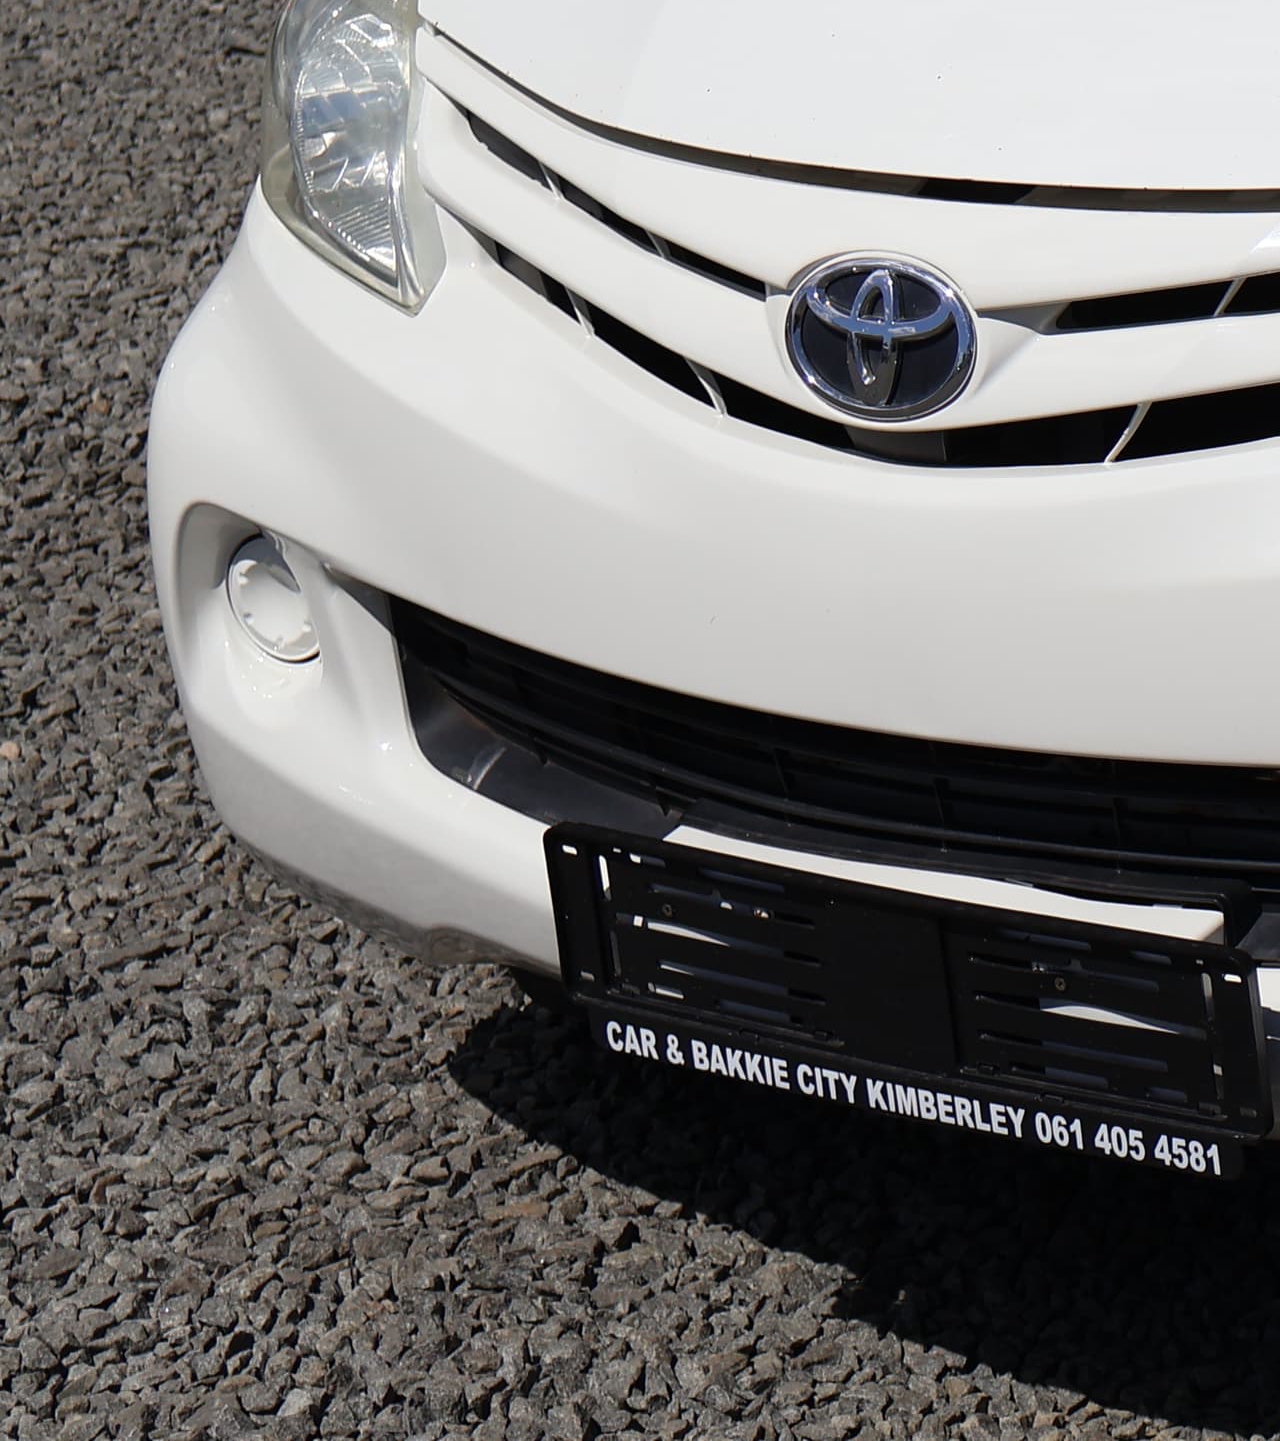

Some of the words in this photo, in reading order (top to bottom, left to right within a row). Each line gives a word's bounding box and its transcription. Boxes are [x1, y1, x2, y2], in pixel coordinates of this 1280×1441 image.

[606, 1020, 659, 1060] CAR
[666, 1034, 685, 1066] &
[691, 1039, 790, 1090] BAKKIE
[797, 1063, 857, 1104] CITY
[866, 1078, 1025, 1138] KIMBERLEY
[1035, 1111, 1083, 1150] 061
[1094, 1123, 1146, 1161] 405
[1154, 1134, 1222, 1176] 4581
